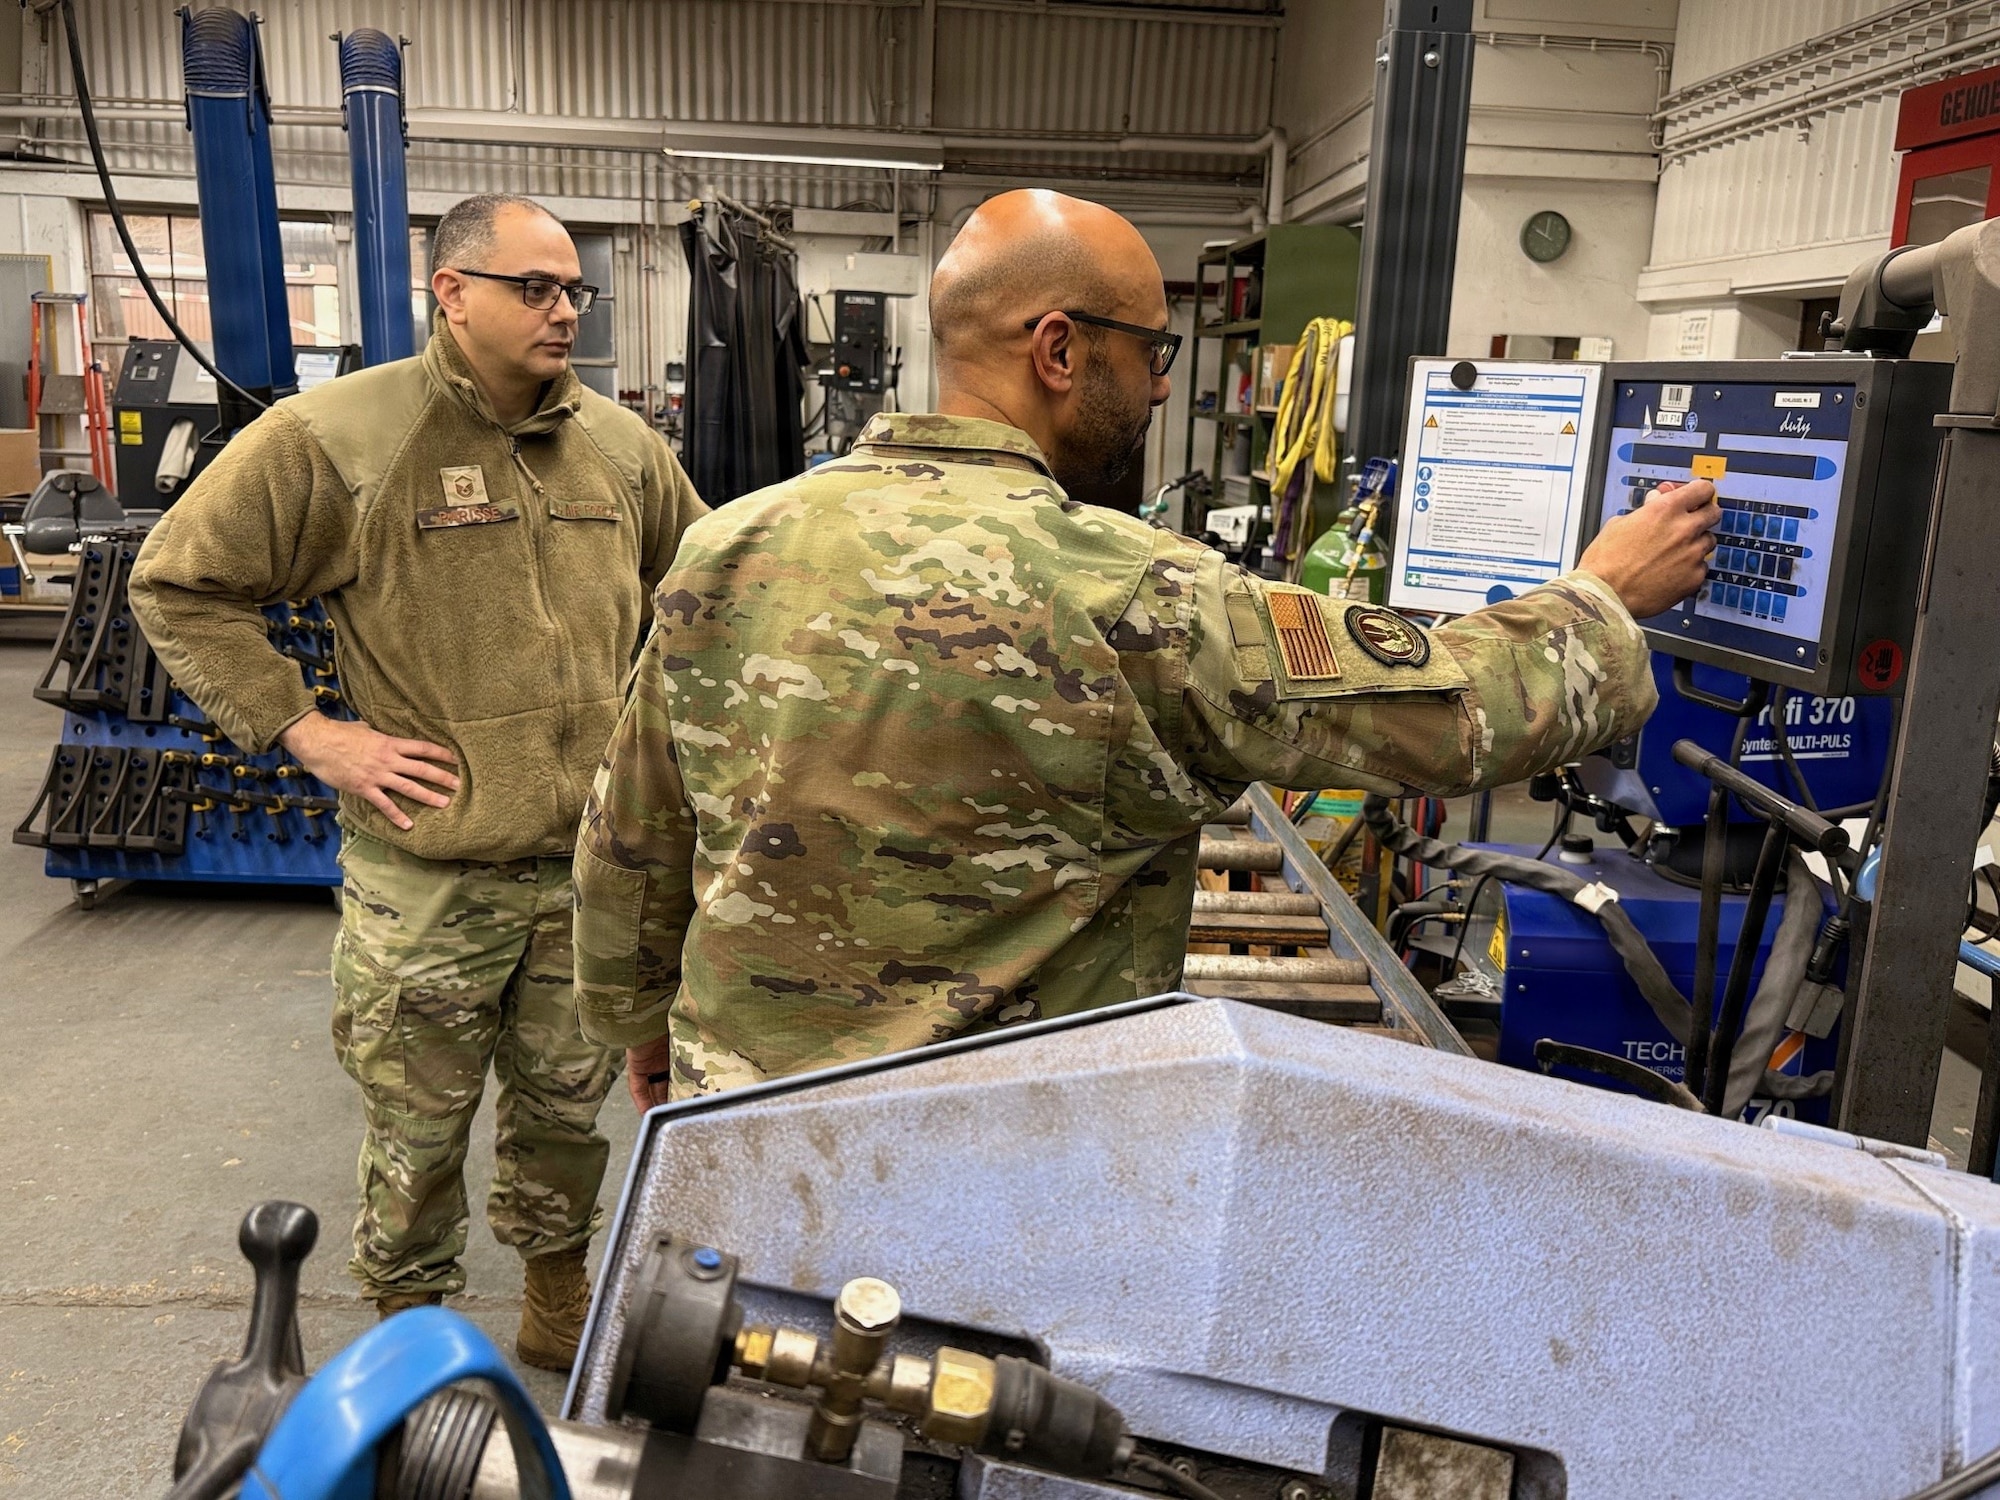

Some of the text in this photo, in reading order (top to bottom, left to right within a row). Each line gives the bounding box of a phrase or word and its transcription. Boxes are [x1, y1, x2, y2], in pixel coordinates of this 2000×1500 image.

[1779, 411, 1811, 441] duty
[438, 506, 501, 523] PARISSE
[565, 504, 579, 517] AIR
[584, 504, 617, 518] FORCE
[1743, 696, 1855, 726] rfi 370
[1622, 1041, 1686, 1061] TECH
